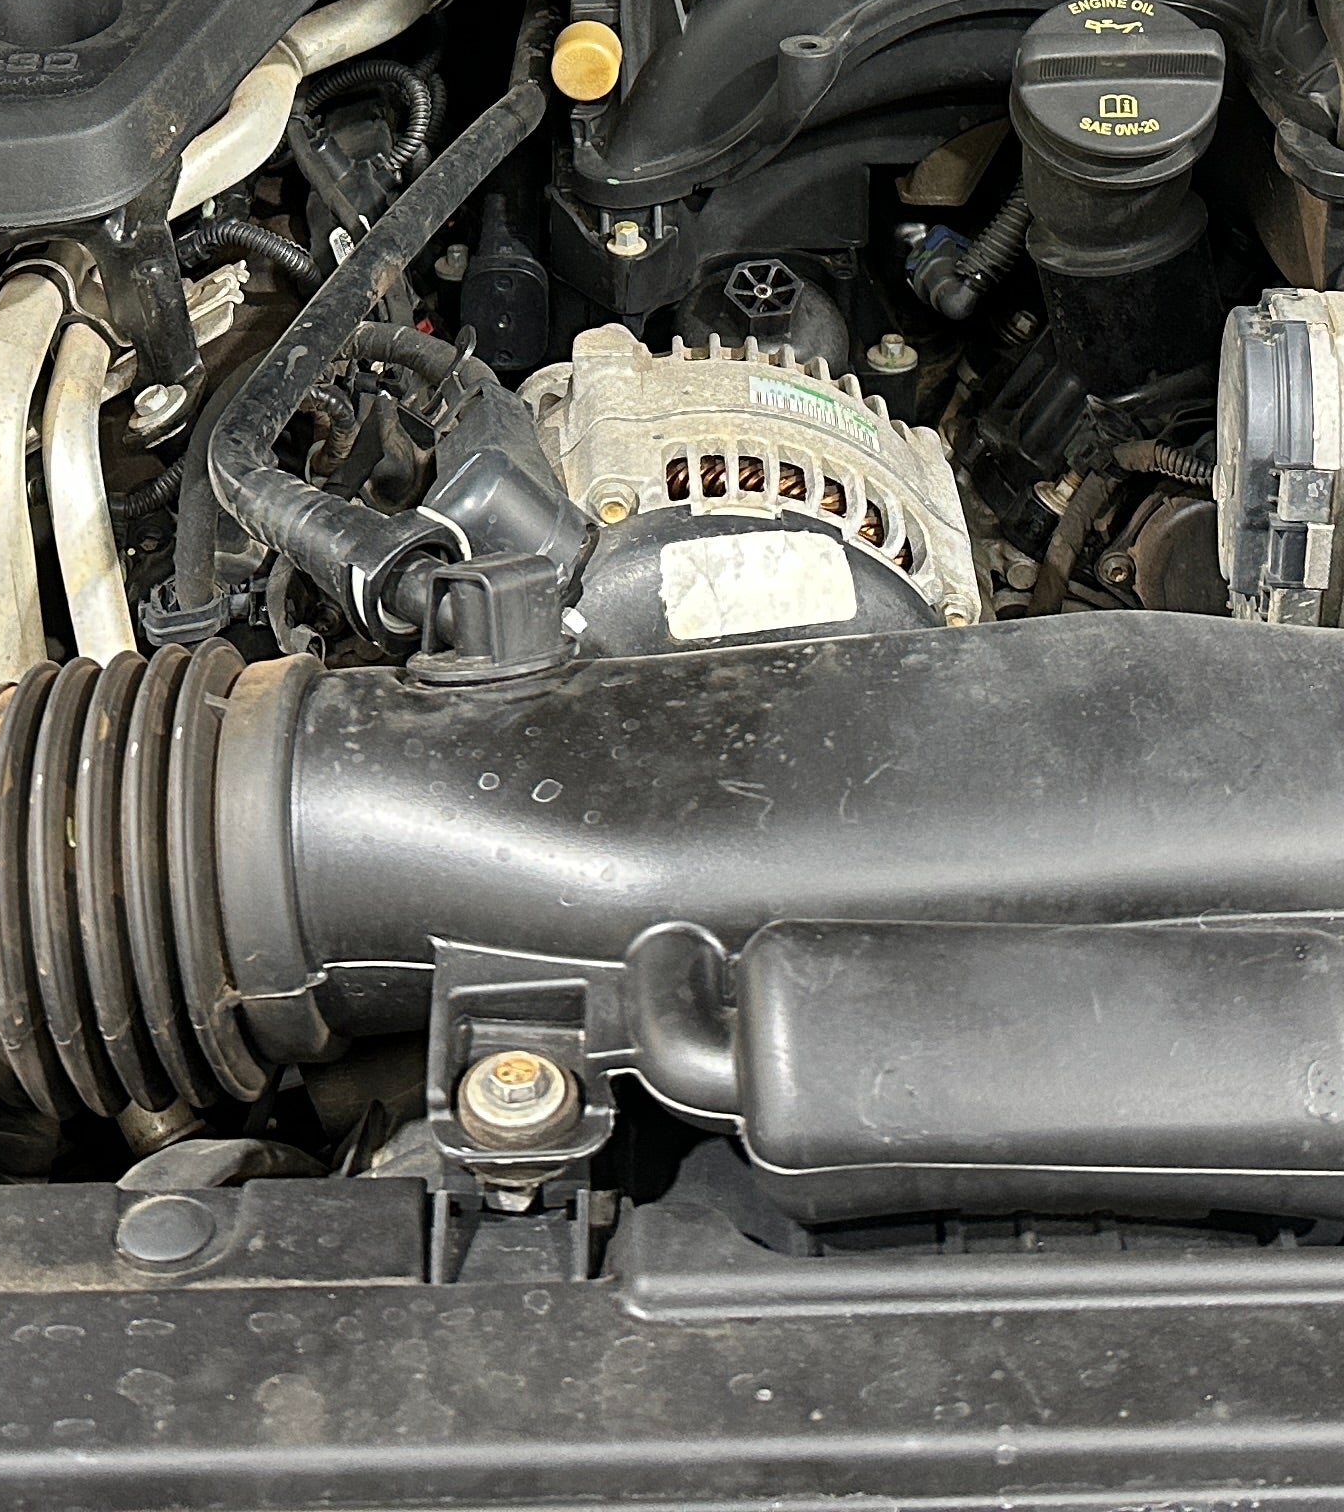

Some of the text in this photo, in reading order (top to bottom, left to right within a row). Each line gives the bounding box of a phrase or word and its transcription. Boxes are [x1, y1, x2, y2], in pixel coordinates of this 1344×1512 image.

[1131, 0, 1155, 16] OIL
[1079, 117, 1160, 136] SAE 0W-20
